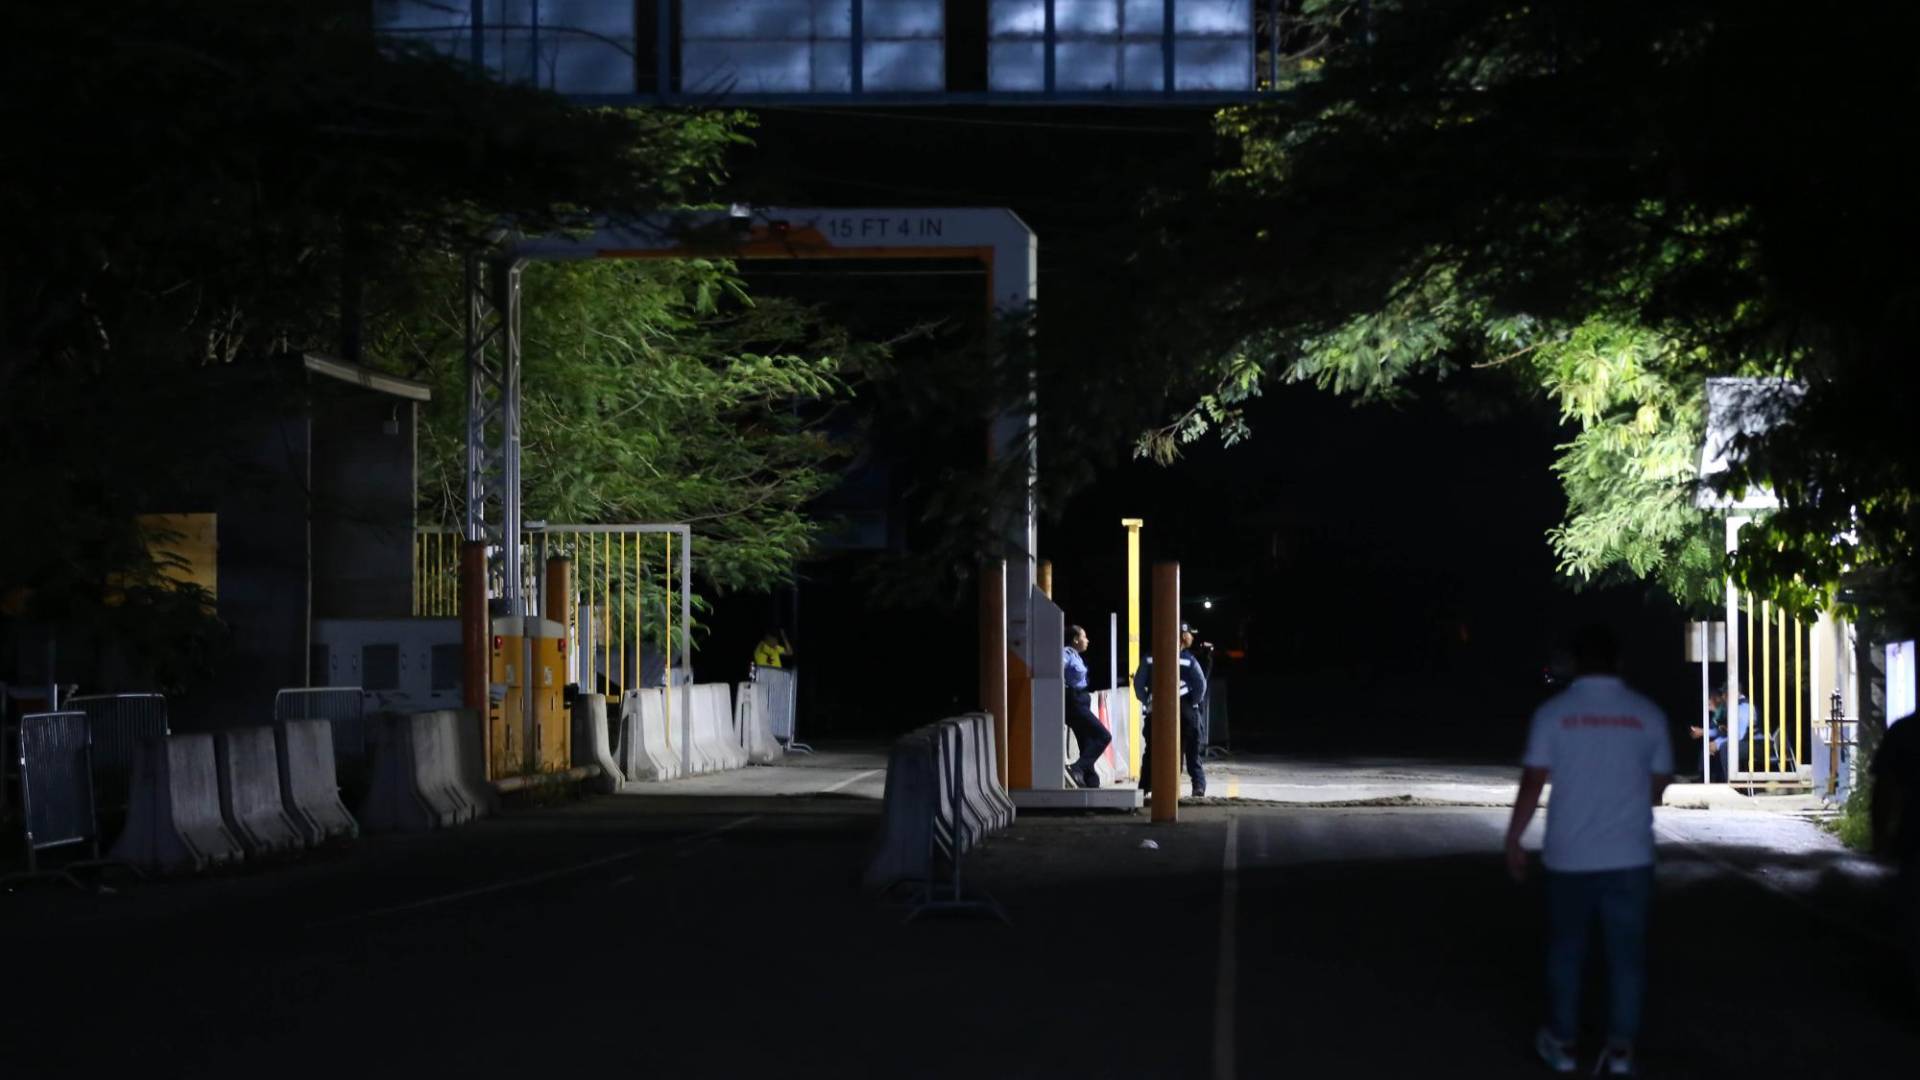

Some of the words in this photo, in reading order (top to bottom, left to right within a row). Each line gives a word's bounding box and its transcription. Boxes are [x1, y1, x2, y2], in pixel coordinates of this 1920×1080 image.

[829, 218, 852, 237] 15
[862, 218, 889, 237] FT
[898, 218, 909, 236] 4
[920, 218, 942, 236] IN
